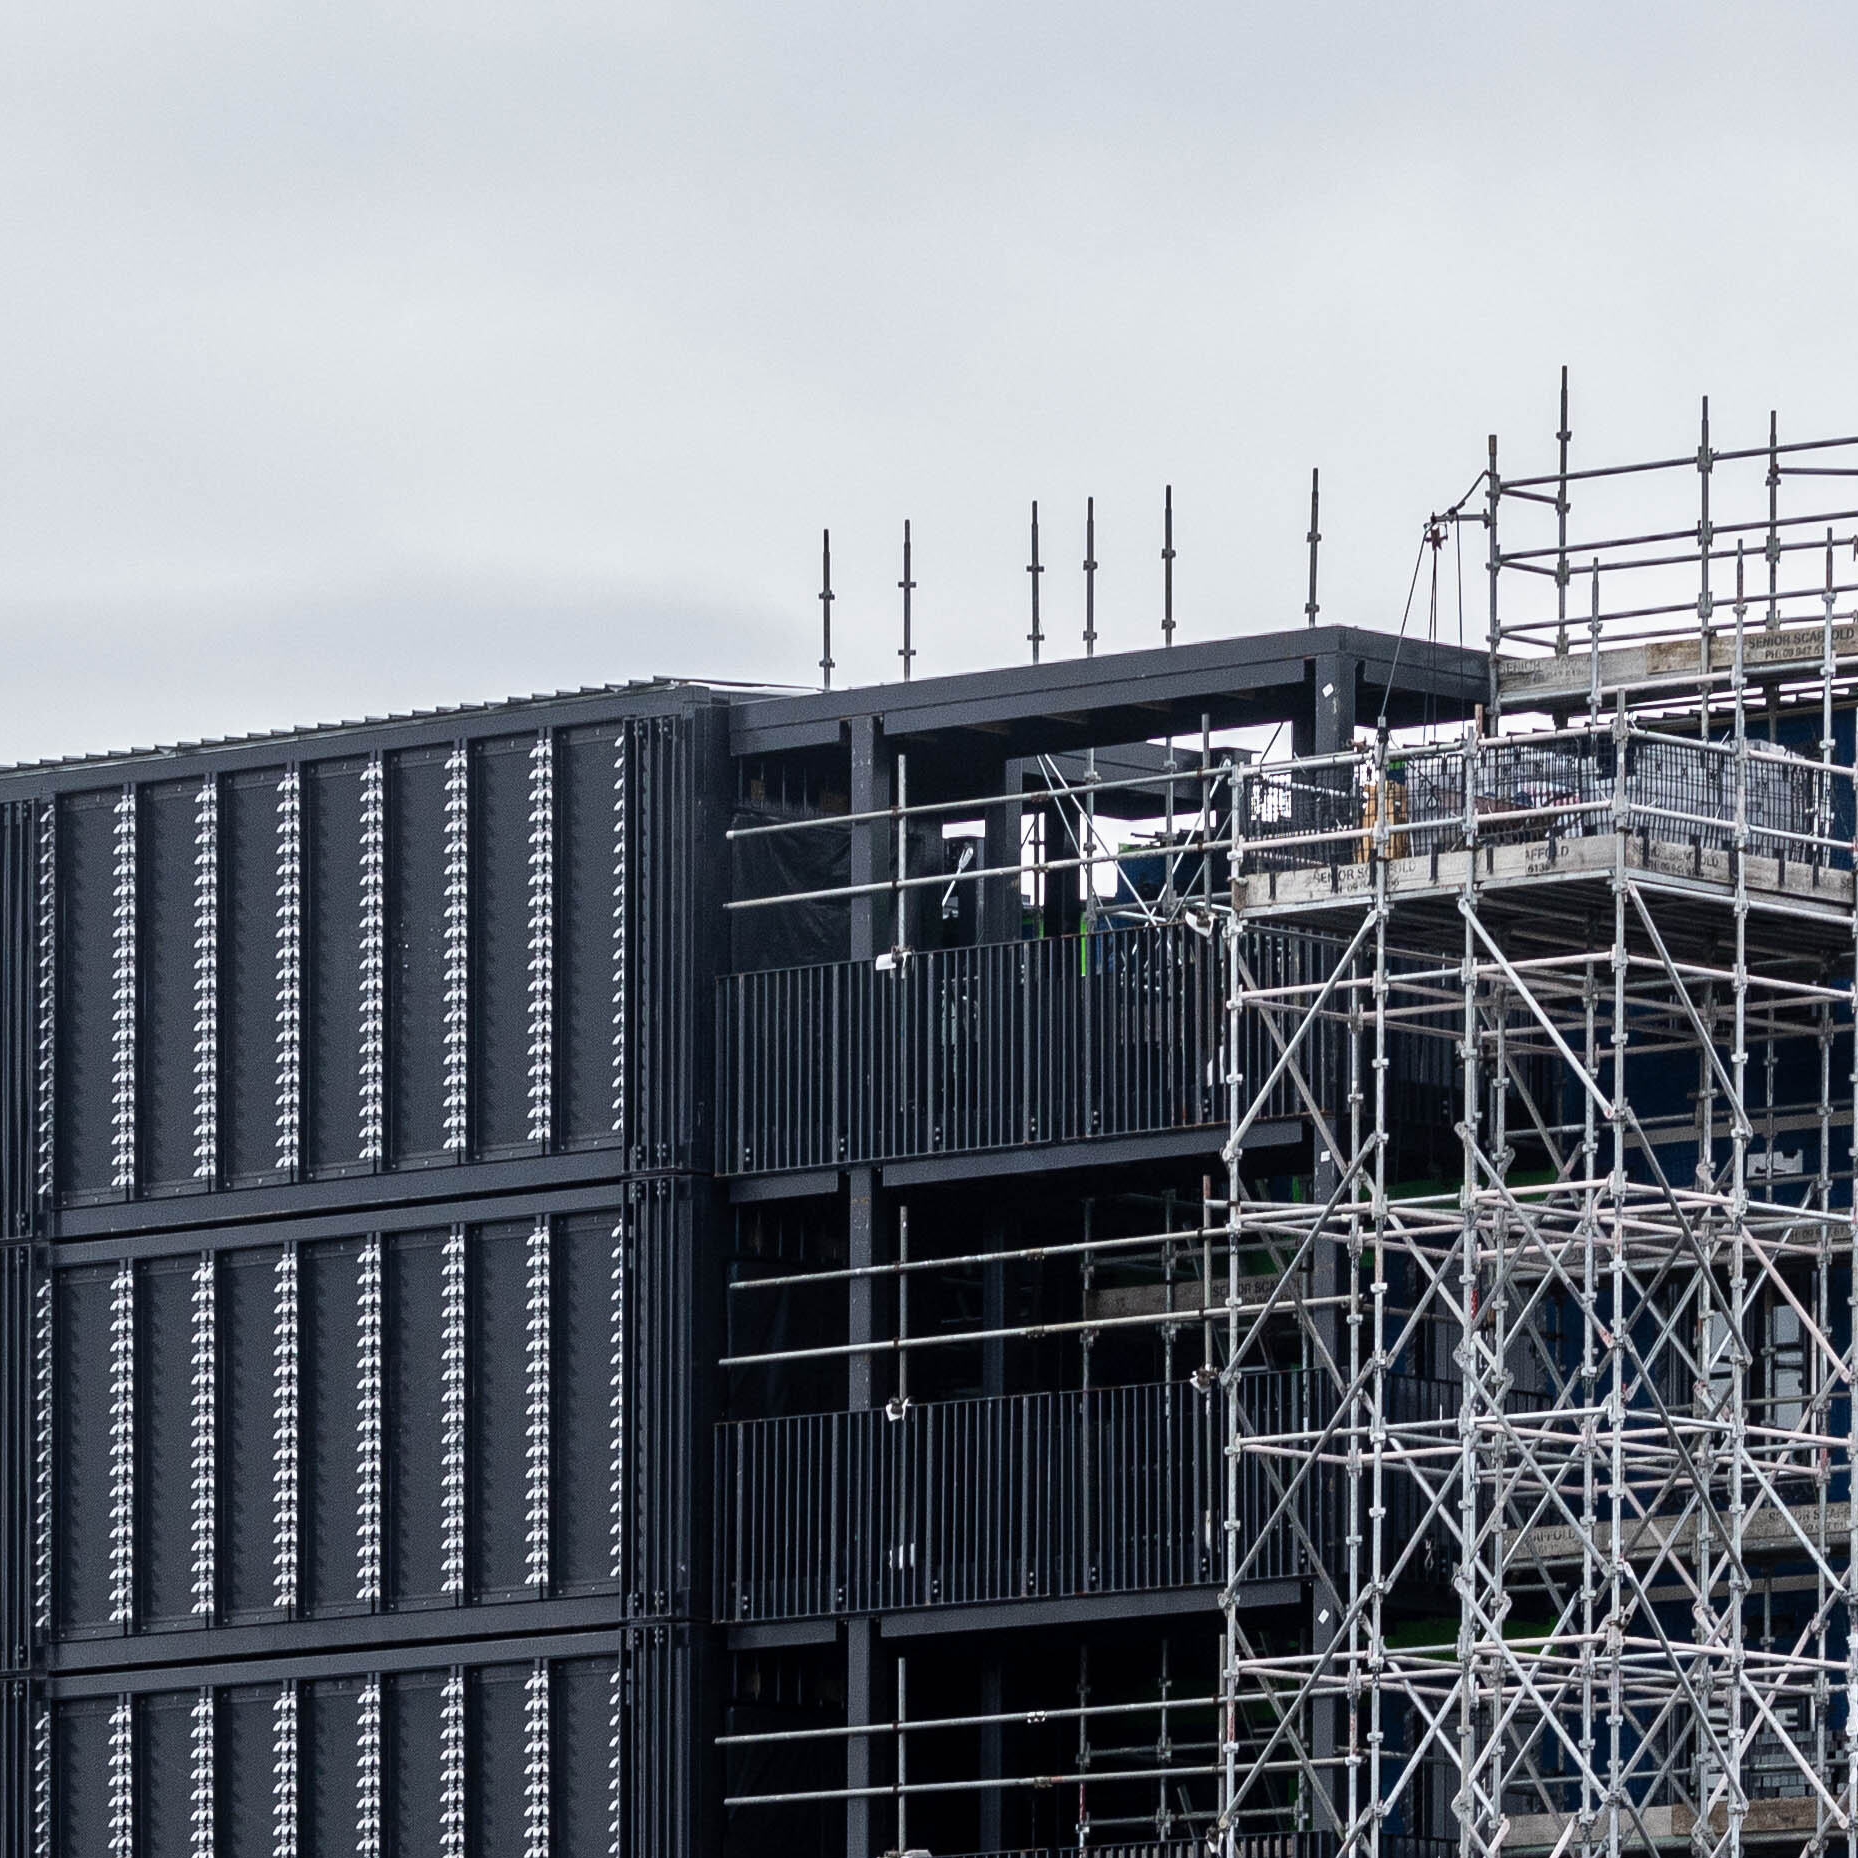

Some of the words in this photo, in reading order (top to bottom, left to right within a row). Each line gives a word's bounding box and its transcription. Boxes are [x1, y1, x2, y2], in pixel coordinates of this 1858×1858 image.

[1749, 634, 1791, 650] SENIOR
[1794, 628, 1855, 646] SCAFOLD
[1314, 868, 1354, 884] SEOR
